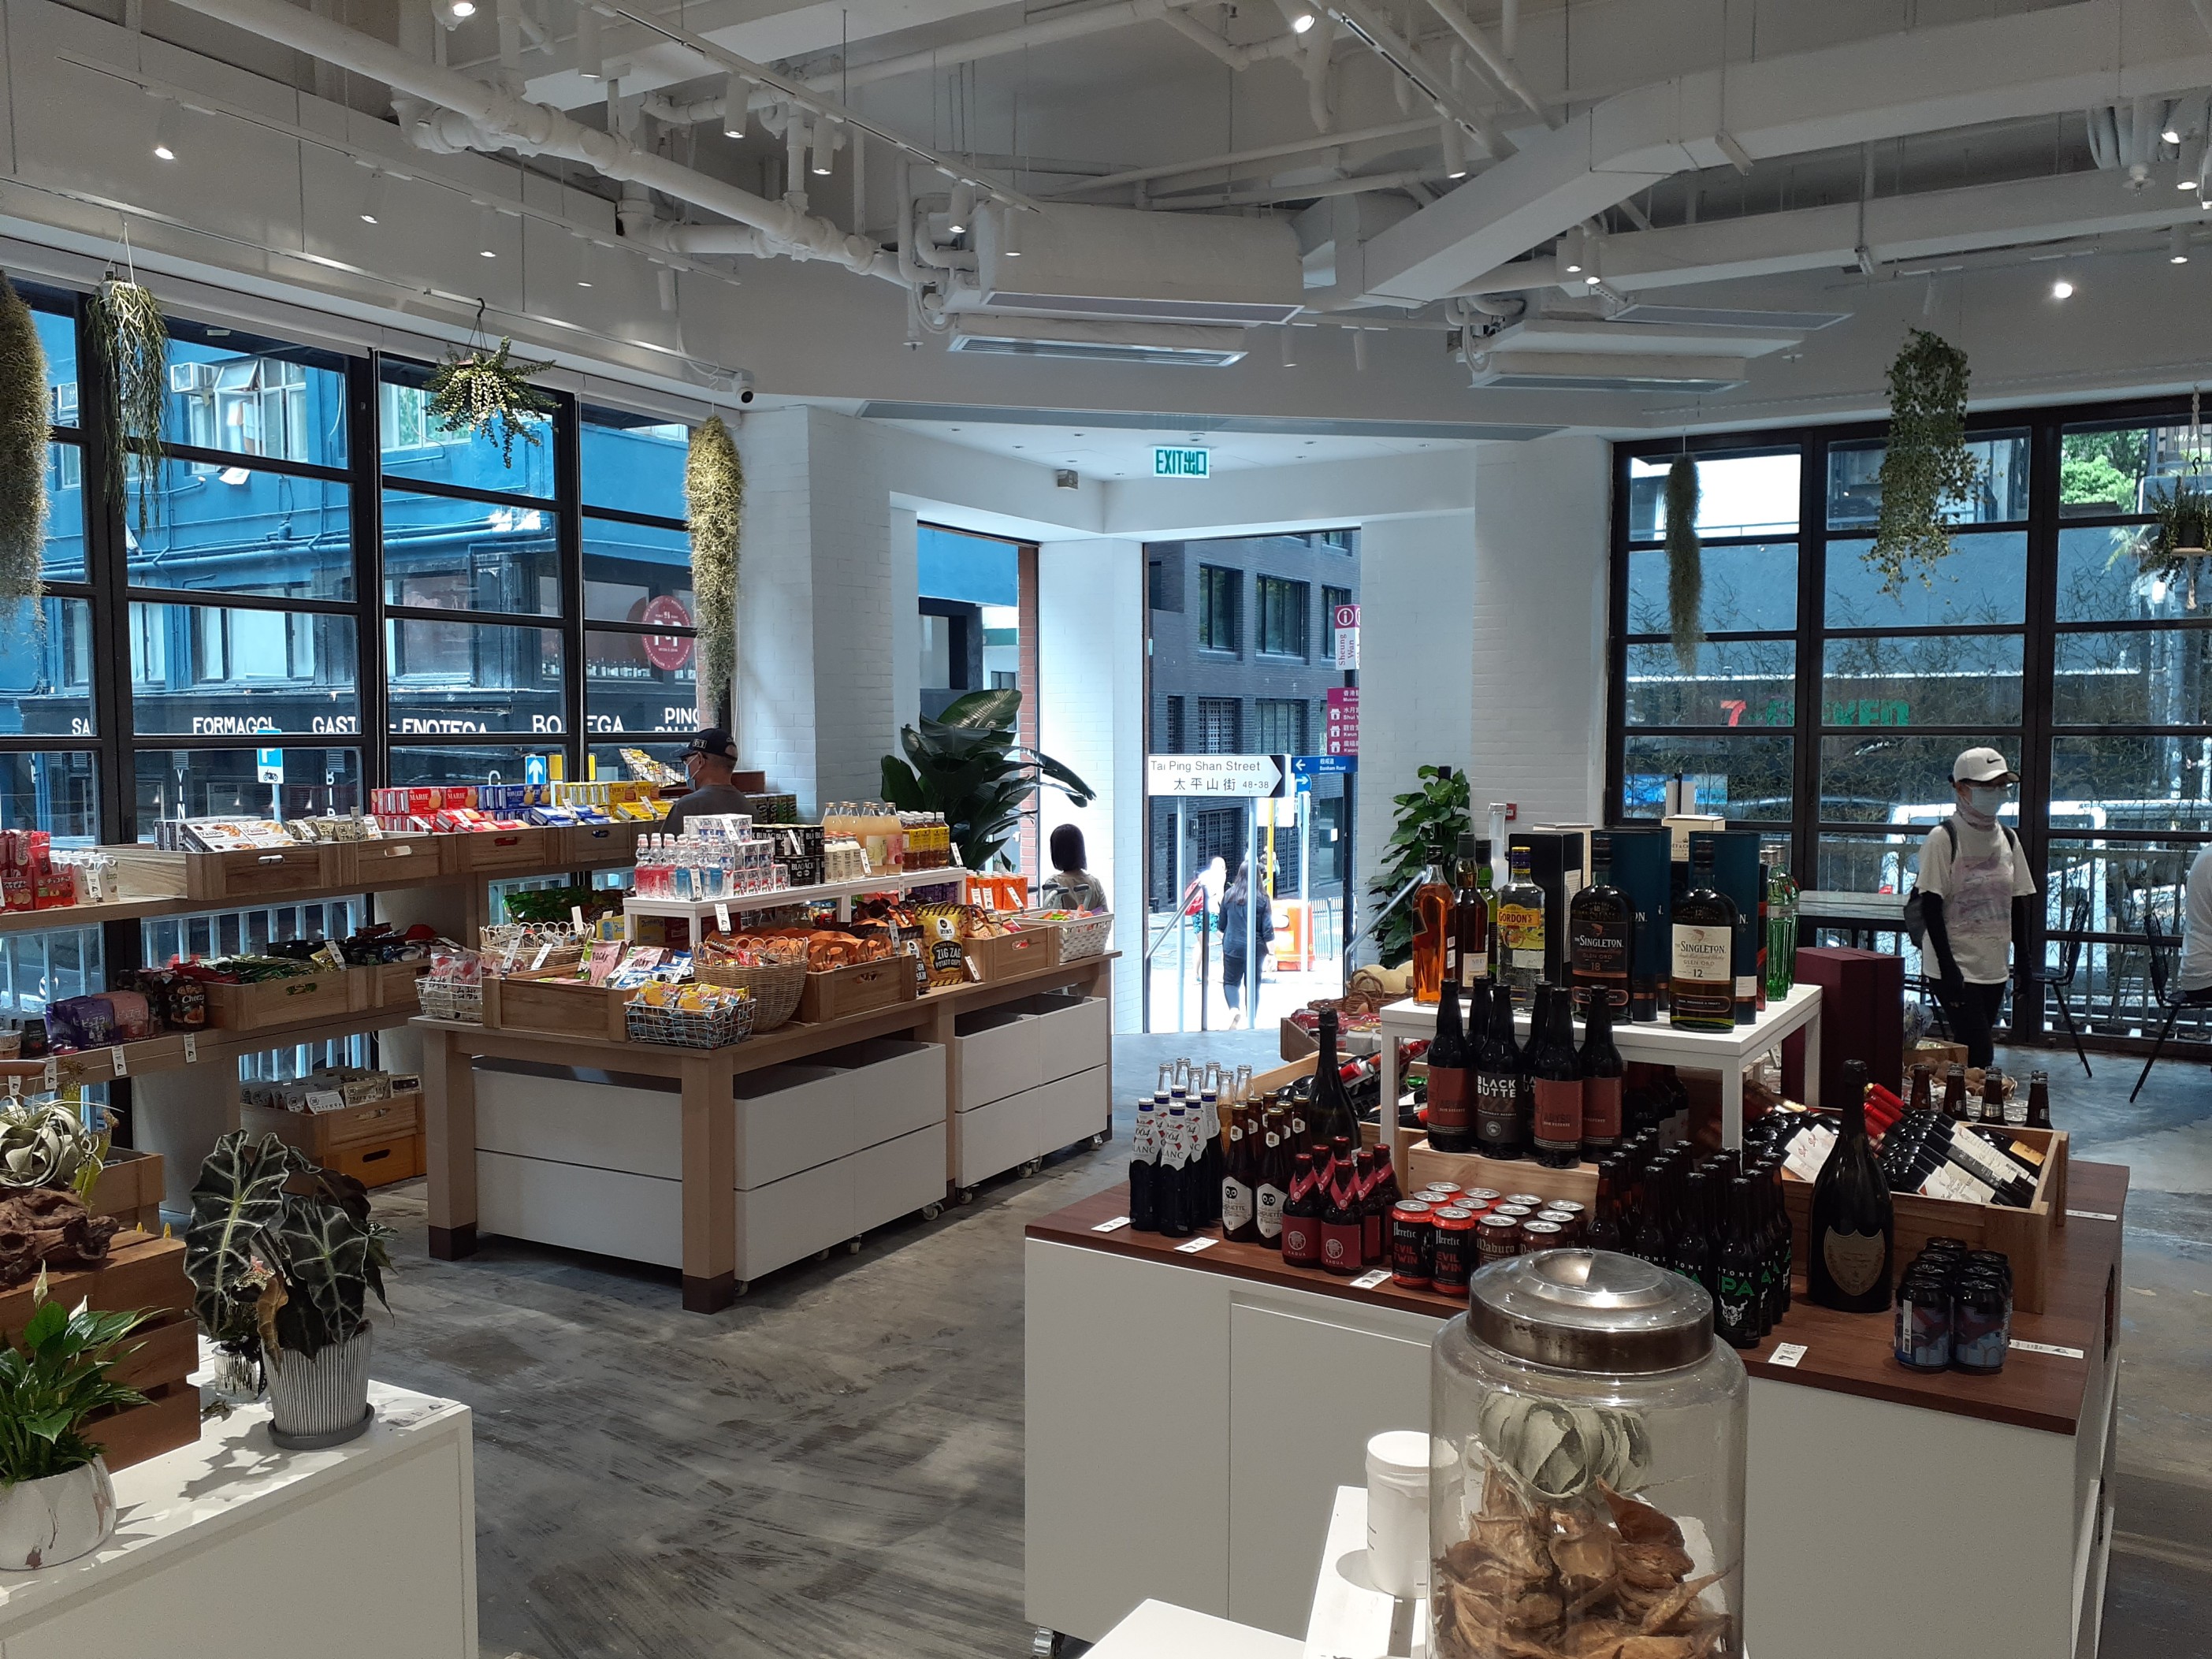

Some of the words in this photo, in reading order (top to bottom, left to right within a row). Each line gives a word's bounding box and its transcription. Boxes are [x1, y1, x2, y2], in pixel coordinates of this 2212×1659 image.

[1156, 449, 1183, 474] EXIT
[1184, 451, 1206, 475] 出口
[1151, 761, 1165, 771] Tai
[1169, 761, 1192, 773] Ping
[1195, 761, 1222, 771] Shan
[1226, 761, 1261, 772] Street
[1174, 778, 1236, 790] 太平山街
[1499, 911, 1532, 923] GORDON'S
[936, 947, 949, 959] ZIG
[950, 947, 961, 958] ZAG
[1591, 962, 1601, 971] 18
[1693, 968, 1704, 978] 12
[1478, 1075, 1516, 1088] BLACK
[1478, 1086, 1516, 1098] BUTTE
[1393, 1221, 1418, 1238] Heretic
[1436, 1229, 1460, 1245] Heretic
[1394, 1243, 1415, 1255] EVIL
[1393, 1253, 1418, 1263] TWIN
[1436, 1251, 1458, 1261] EVIL
[1437, 1260, 1463, 1272] TWIN
[1717, 1274, 1755, 1296] IPA
